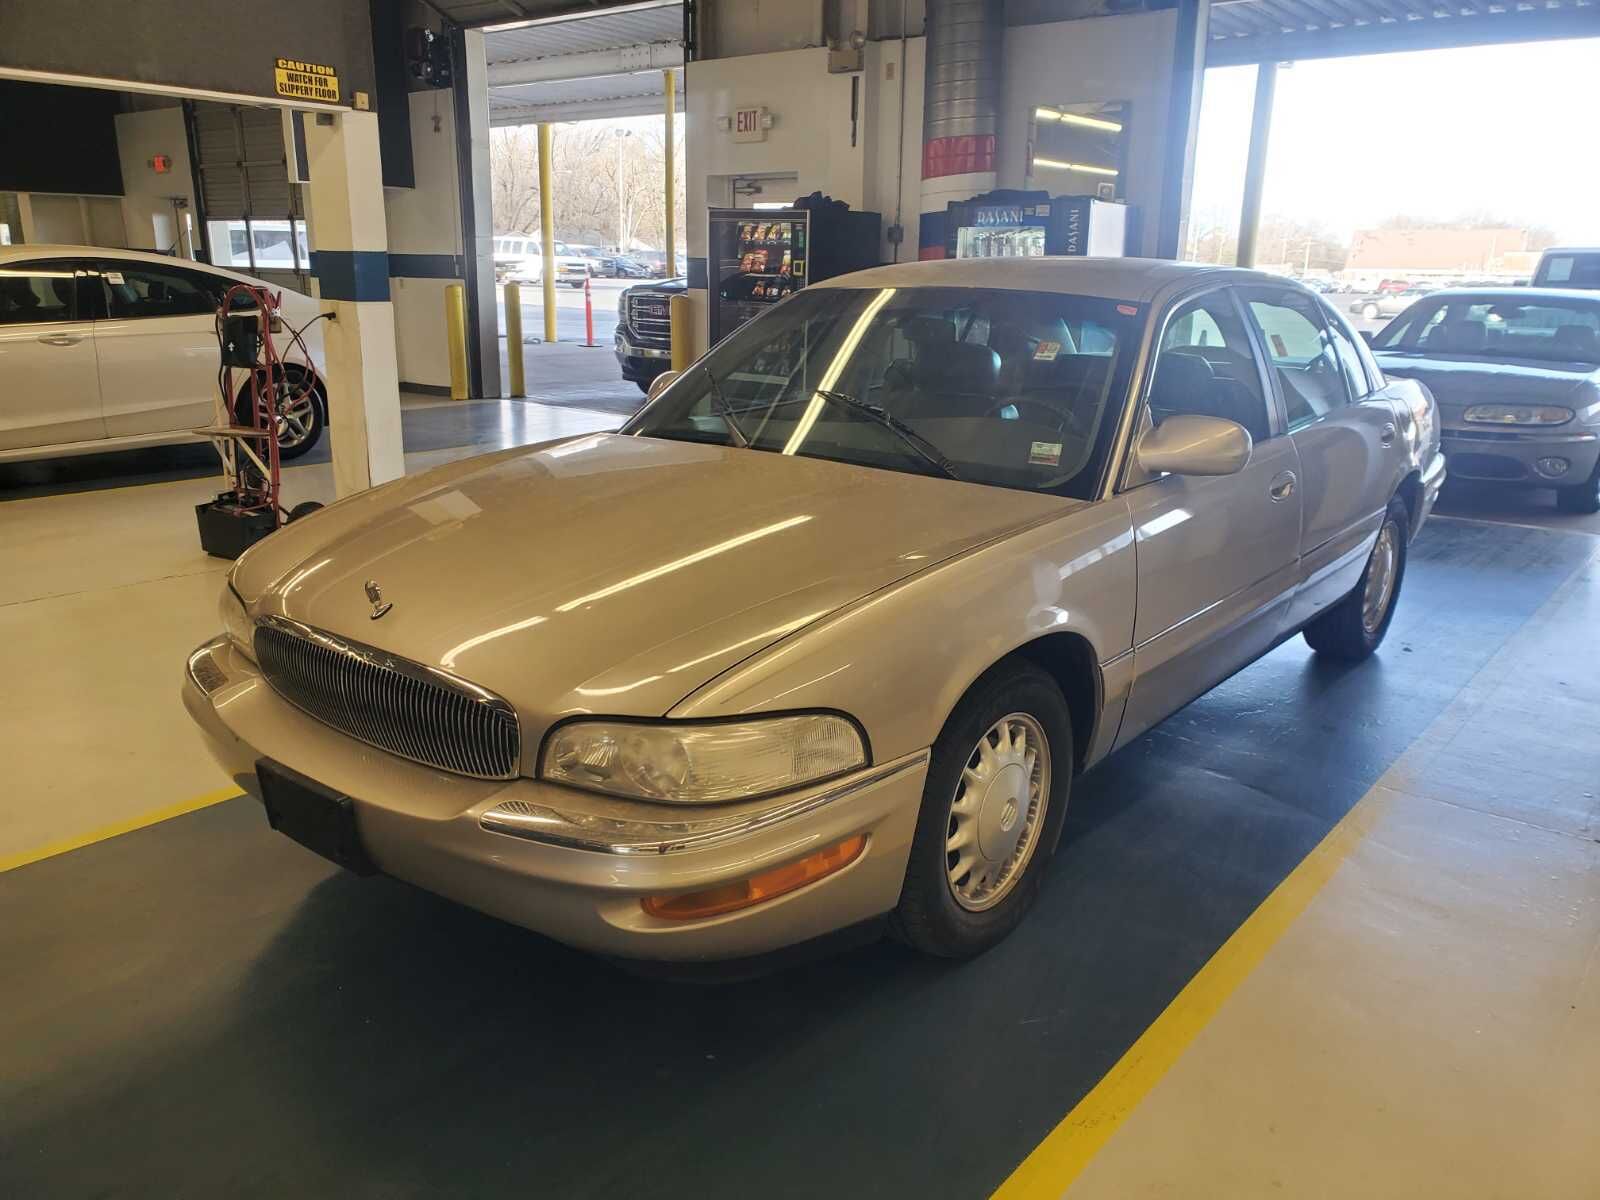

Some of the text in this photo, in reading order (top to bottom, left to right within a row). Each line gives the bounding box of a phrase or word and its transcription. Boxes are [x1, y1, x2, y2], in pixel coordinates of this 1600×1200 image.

[278, 59, 335, 75] CAUTION
[287, 72, 329, 88] WATCH FOR
[279, 82, 337, 99] SLIPPERY FLOOR
[737, 111, 758, 132] EXIT
[977, 208, 1024, 225] DASANI
[1067, 209, 1080, 252] DASANI
[650, 304, 670, 316] GM
